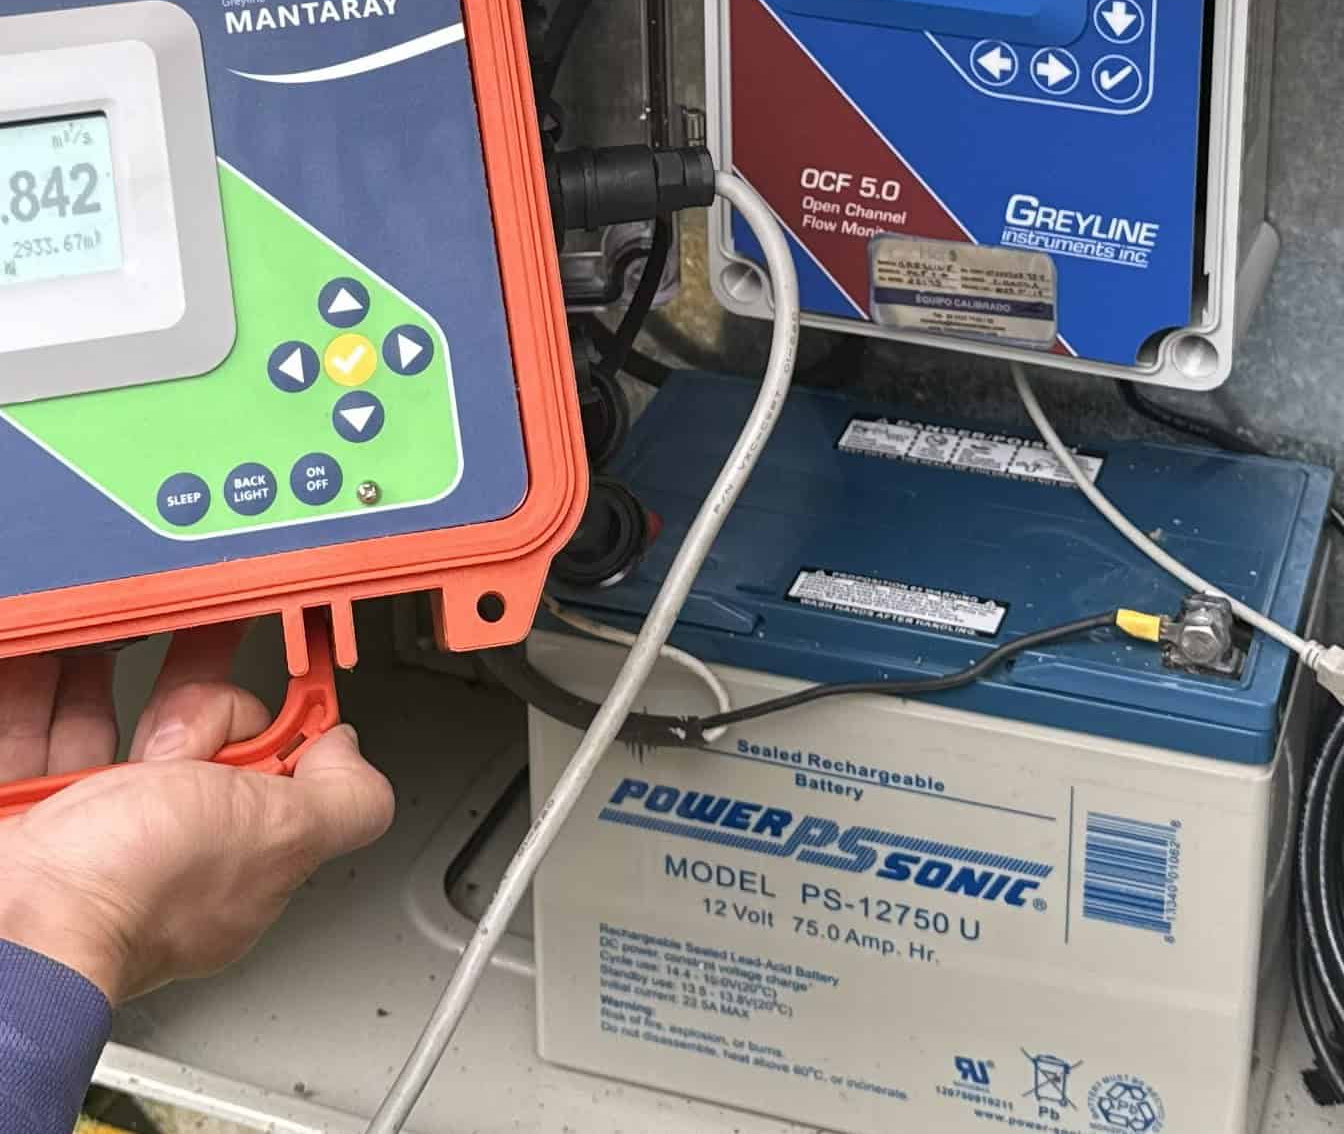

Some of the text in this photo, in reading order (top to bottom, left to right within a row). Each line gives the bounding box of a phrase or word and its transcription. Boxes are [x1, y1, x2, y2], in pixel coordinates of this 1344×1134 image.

[800, 168, 901, 202] OCF 5.0
[802, 195, 908, 226] Open Channel
[802, 214, 838, 232] Flow
[1001, 229, 1116, 259] instruments
[233, 475, 267, 489] BACK
[306, 466, 326, 478] ON
[306, 479, 329, 492] OFF
[166, 492, 202, 508] SLEEP
[233, 487, 270, 503] LIGHT
[875, 610, 915, 626] AFTER
[915, 619, 977, 636] HANDLING
[736, 738, 946, 793] Sealed Rechargeable
[794, 772, 864, 802] Battery
[609, 777, 793, 838] POWER
[875, 851, 1041, 907] SONIC
[665, 853, 981, 941] MODEL PS-12750 U
[703, 897, 940, 964] 12 Volt 75.0 Amp. Hr.
[599, 922, 682, 950] Rechargeable
[685, 941, 728, 961] Sealed
[795, 965, 840, 987] Battery
[599, 949, 633, 968] Cycle
[599, 935, 619, 949] DC
[719, 964, 763, 983] voltage
[599, 963, 648, 985] Standby
[719, 1003, 751, 1019] MAX
[629, 1013, 641, 1025] of
[733, 1038, 746, 1049] or
[600, 1020, 619, 1034] Do
[621, 1025, 640, 1038] not
[723, 1048, 751, 1065] heat
[752, 1056, 791, 1074] above
[830, 1074, 844, 1086] or
[1037, 1105, 1061, 1122] Pb
